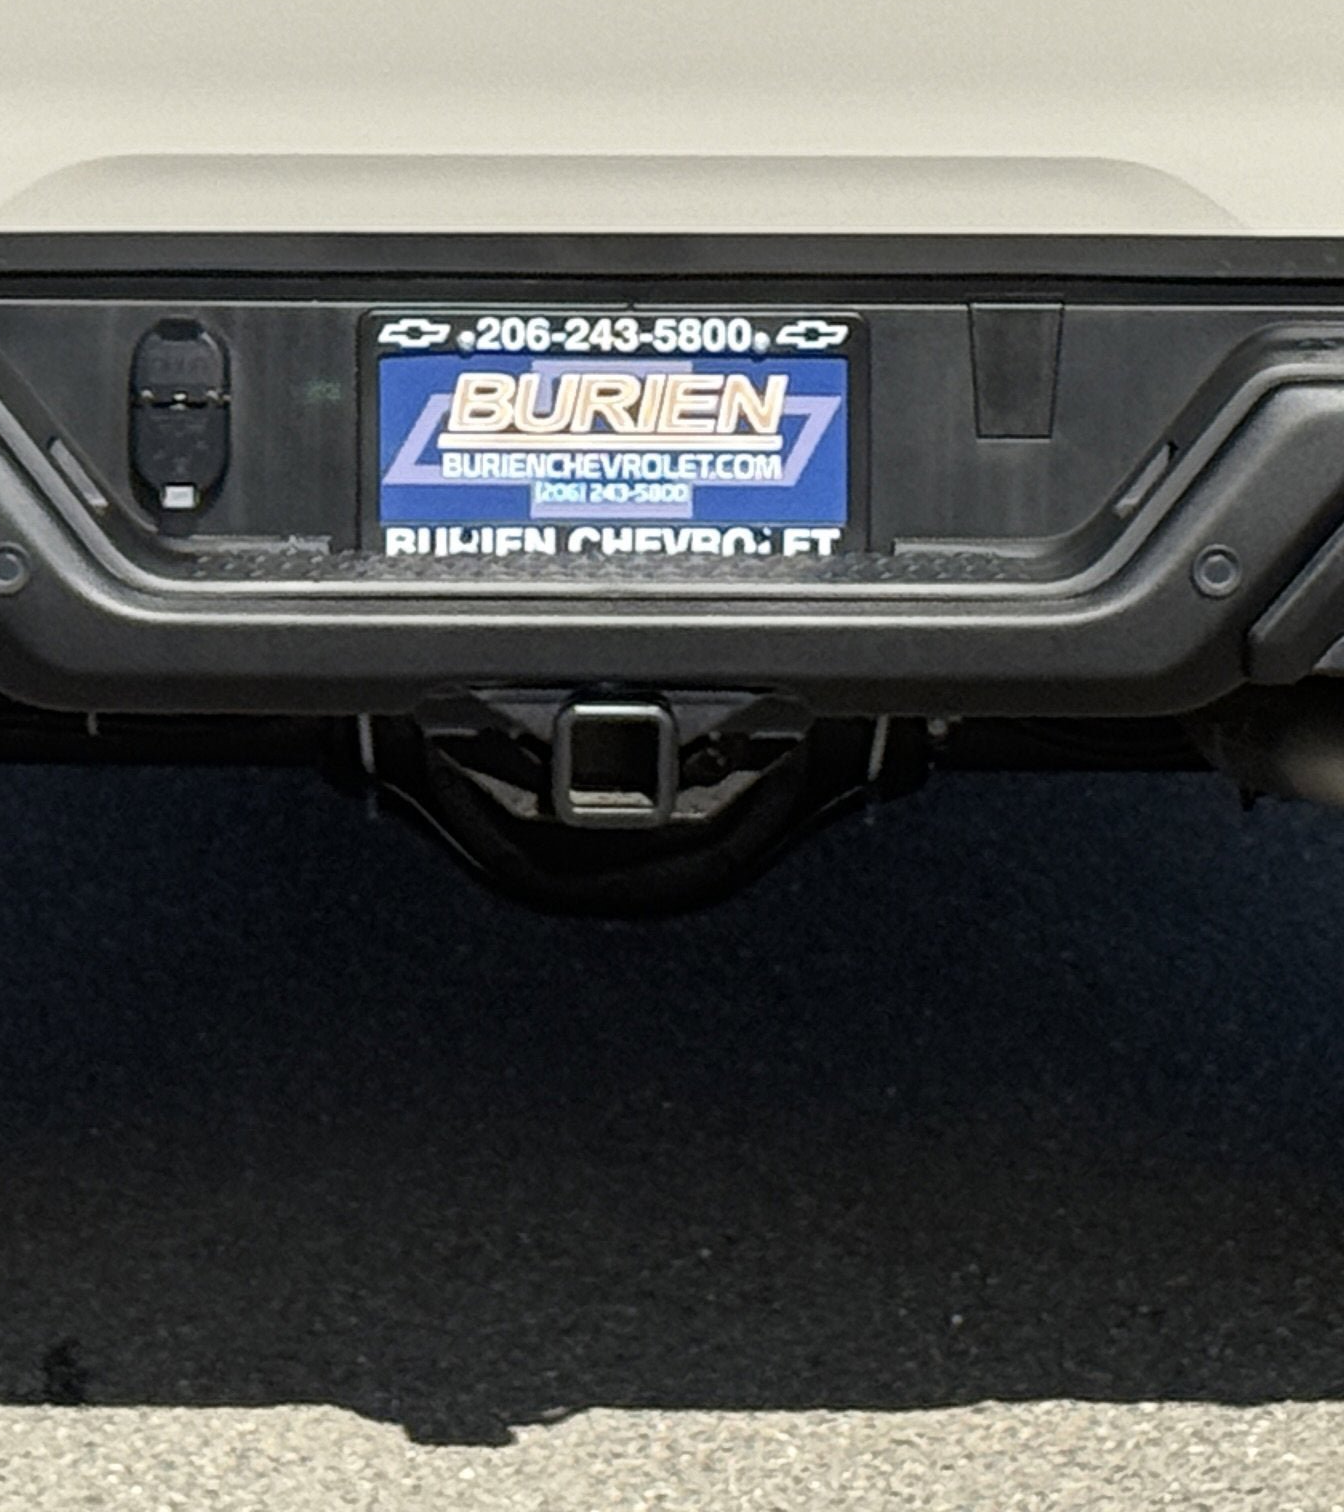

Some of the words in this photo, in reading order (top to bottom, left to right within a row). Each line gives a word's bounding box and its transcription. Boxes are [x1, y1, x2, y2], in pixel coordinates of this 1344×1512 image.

[475, 317, 753, 352] 206-243-5800
[446, 371, 790, 435] BURIEN
[441, 452, 783, 481] BURIENCHEVROLET.COM
[589, 481, 688, 503] 243-5800
[566, 526, 842, 557] CHEVROET
